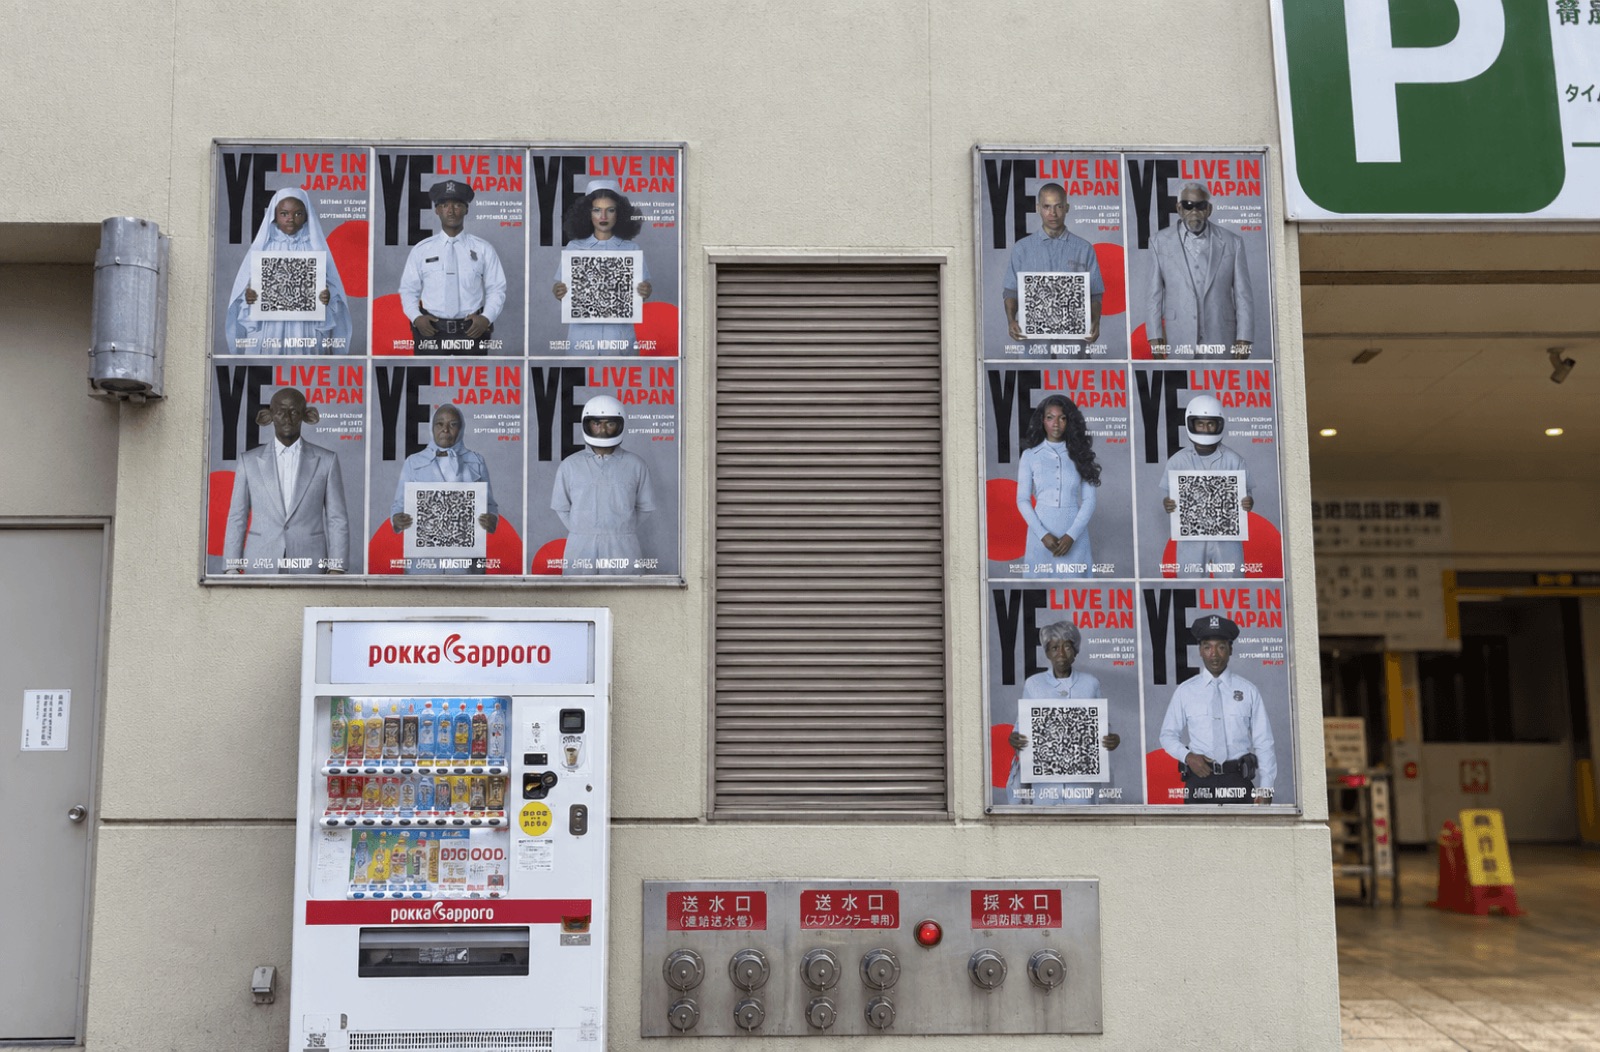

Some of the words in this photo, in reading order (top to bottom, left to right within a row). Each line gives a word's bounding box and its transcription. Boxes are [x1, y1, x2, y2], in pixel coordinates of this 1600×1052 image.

[1344, 0, 1506, 162] P
[1565, 84, 1600, 103] タイ
[280, 153, 334, 173] LIVE
[341, 153, 366, 173] IN
[436, 154, 490, 175] LIVE
[498, 154, 522, 175] IN
[589, 156, 642, 177] LIVE
[650, 156, 674, 177] IN
[1039, 159, 1088, 179] LIVE
[1095, 159, 1118, 179] IN
[1181, 159, 1230, 179] LIVE
[1236, 159, 1260, 179] IN
[300, 175, 366, 191] JAPAN
[618, 177, 674, 193] APAN
[378, 155, 433, 246] YE
[984, 159, 1036, 249] YE
[1127, 159, 1178, 249] YE
[276, 365, 331, 387] LIVE
[338, 365, 363, 387] IN
[434, 366, 488, 387] LIVE
[496, 366, 520, 387] IN
[588, 366, 642, 387] LIVE
[650, 366, 674, 387] IN
[1044, 369, 1095, 391] LIVE
[1102, 369, 1126, 391] IN
[1190, 369, 1241, 391] LIVE
[1246, 369, 1270, 391] IN
[452, 388, 520, 405] JAPAN
[216, 365, 272, 460] YE
[376, 366, 431, 460] YE
[531, 367, 585, 461] YE
[1135, 370, 1188, 463] YE
[1050, 588, 1102, 610] LIVE
[1109, 588, 1133, 610] IN
[1199, 588, 1250, 610] LIVE
[1257, 588, 1281, 610] IN
[993, 589, 1048, 685] YE
[1143, 589, 1200, 685] YE
[682, 895, 750, 912] 送水口
[816, 894, 883, 911] 送水口
[983, 894, 1048, 911] 採水口
